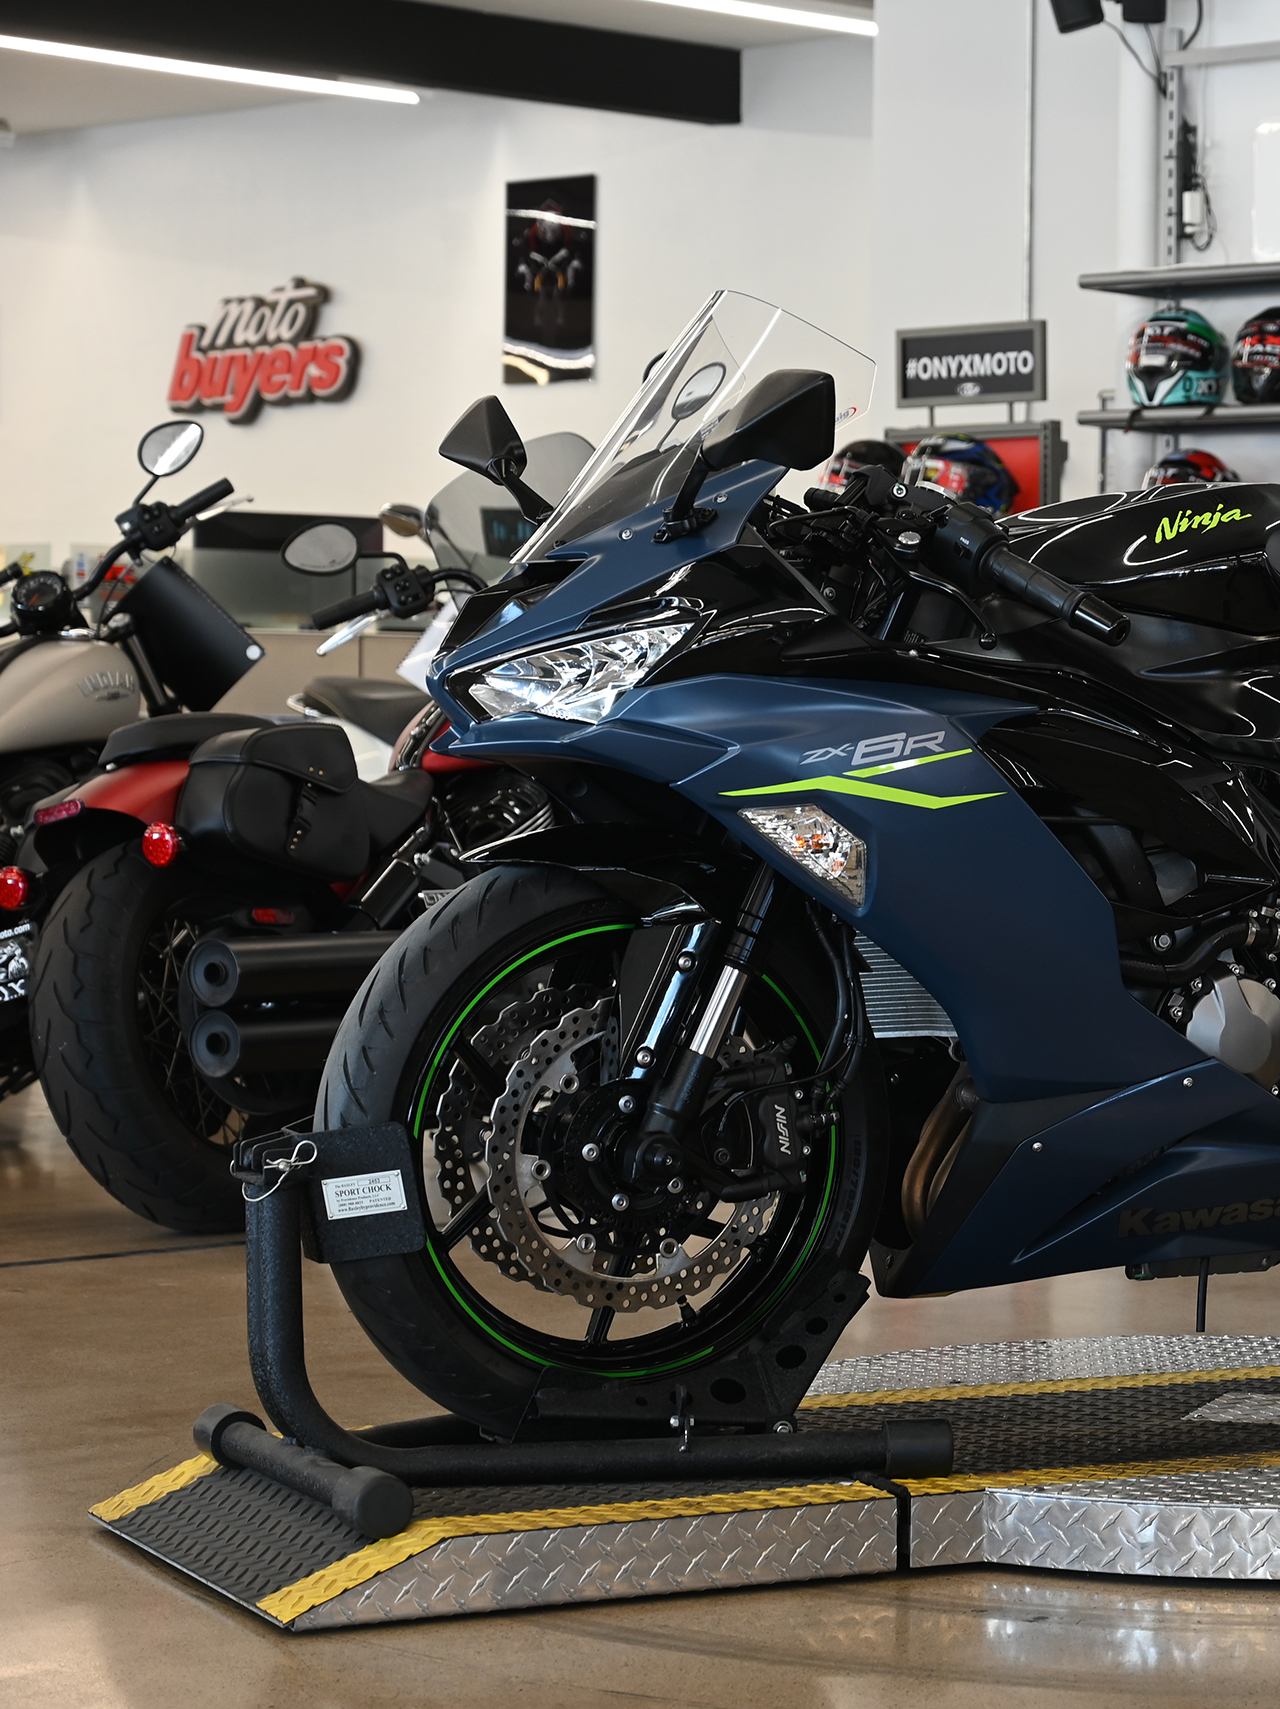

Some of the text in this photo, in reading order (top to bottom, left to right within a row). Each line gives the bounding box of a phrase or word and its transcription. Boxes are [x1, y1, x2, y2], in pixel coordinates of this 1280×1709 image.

[168, 331, 346, 414] buyers
[905, 350, 1035, 380] #ONYXMOTO
[1155, 503, 1253, 544] Ninja
[799, 730, 946, 766] ZX-6R
[774, 1104, 792, 1155] NISSIN
[334, 1183, 392, 1198] SPORT CHOCK
